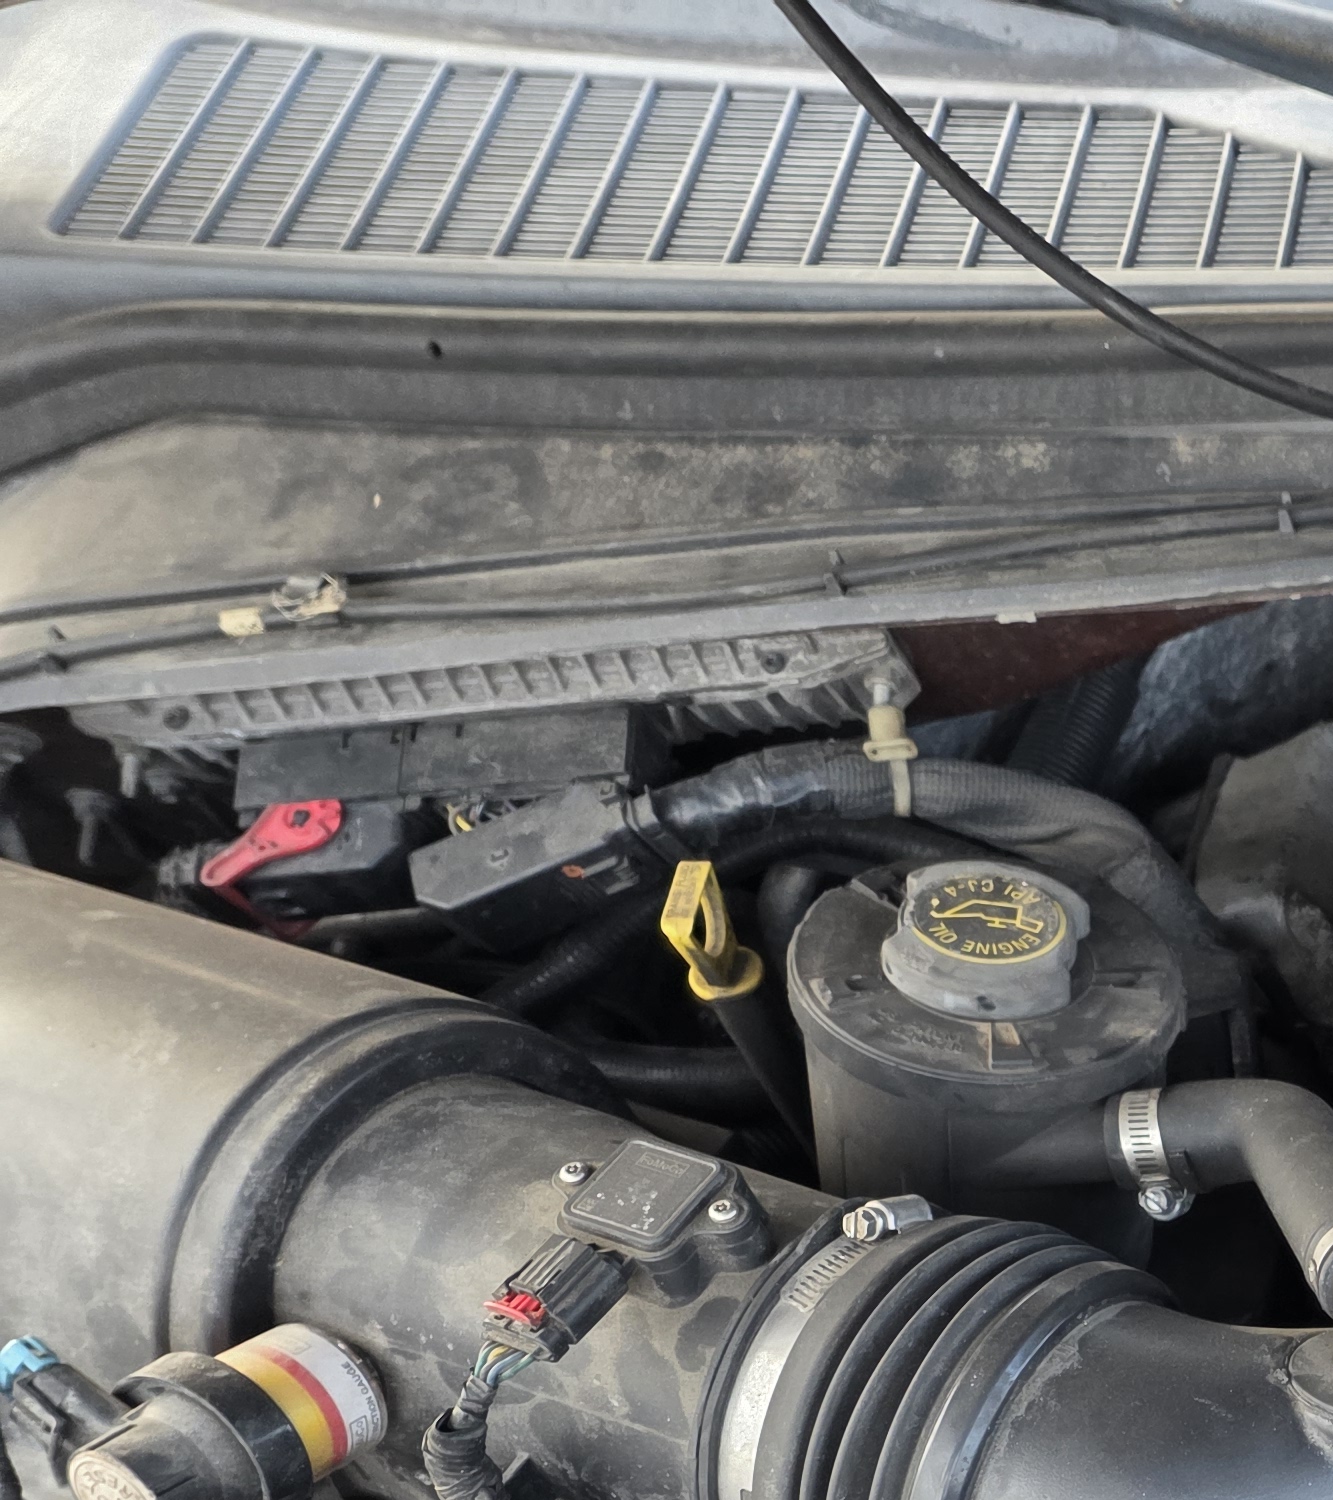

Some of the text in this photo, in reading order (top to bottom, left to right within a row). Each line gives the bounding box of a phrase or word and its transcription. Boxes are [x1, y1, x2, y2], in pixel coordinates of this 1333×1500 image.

[928, 920, 1042, 955] ENGINE OIL
[341, 1361, 370, 1395] GAUGE
